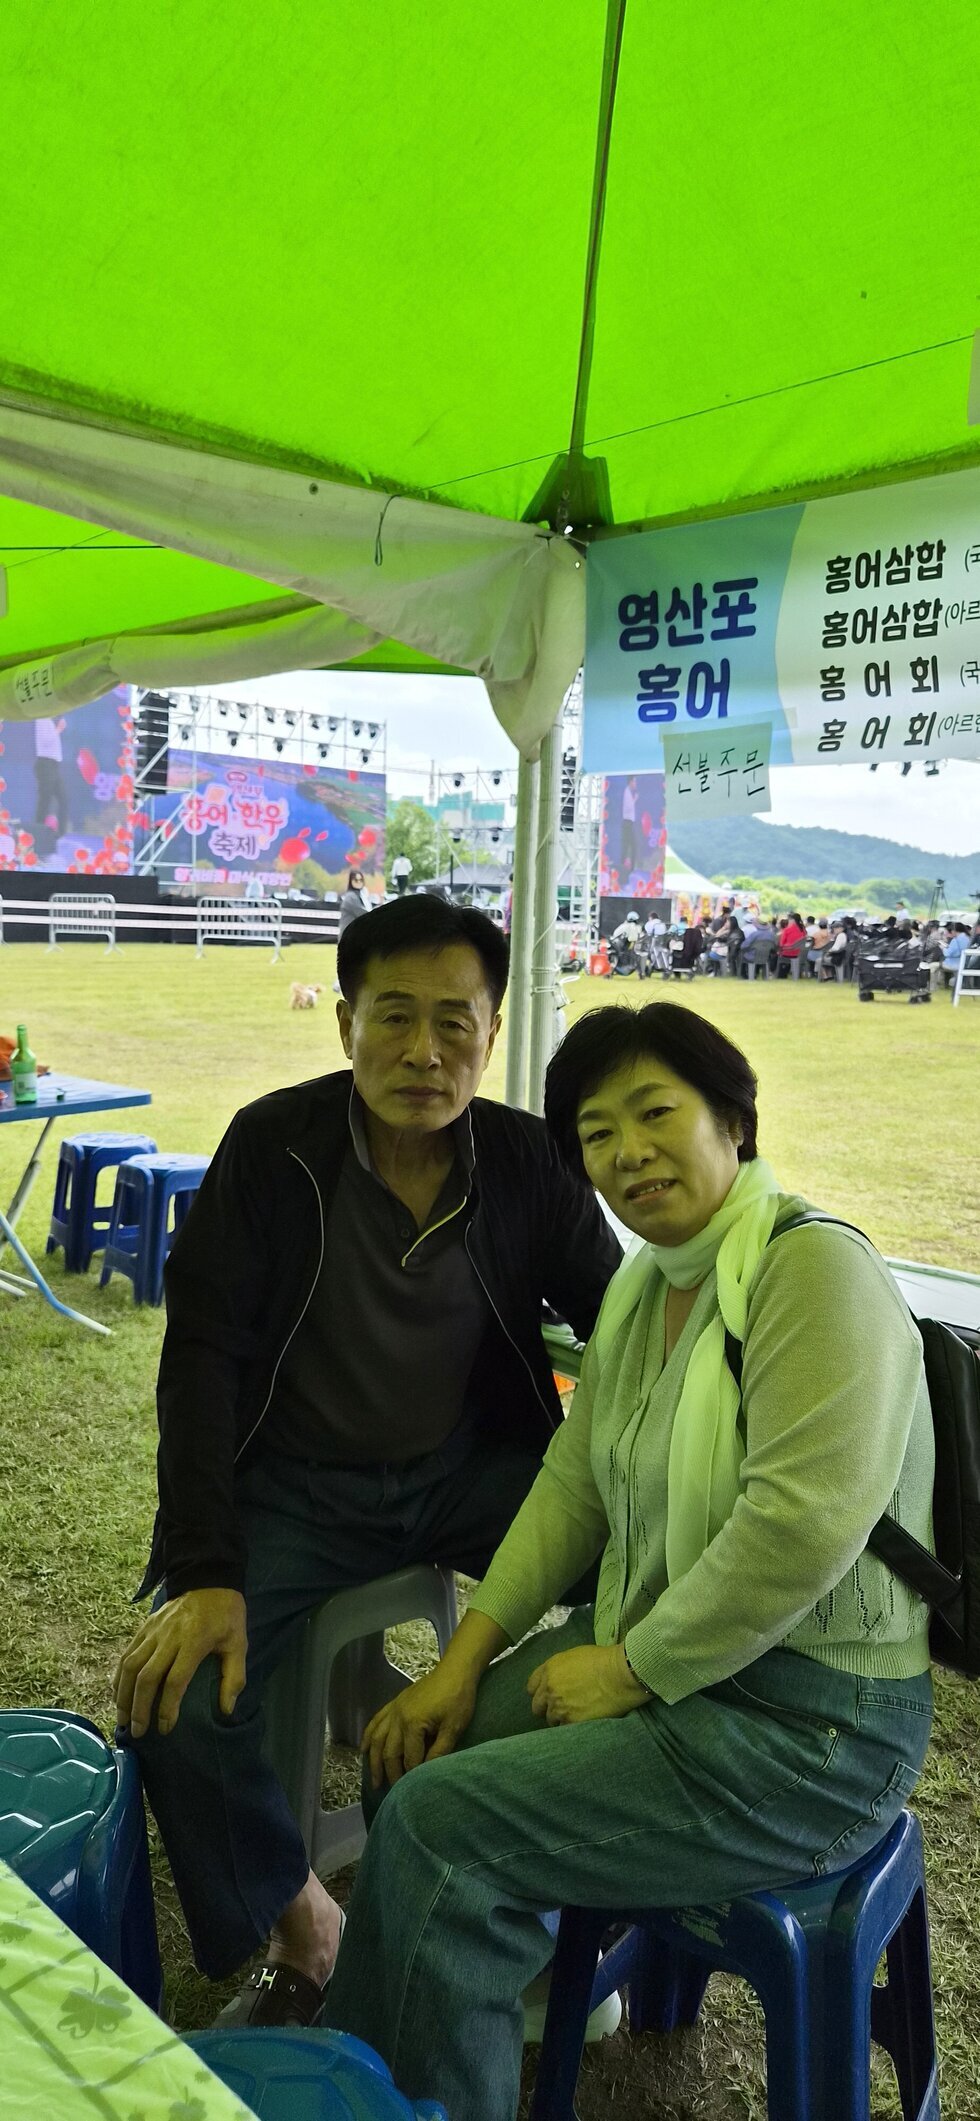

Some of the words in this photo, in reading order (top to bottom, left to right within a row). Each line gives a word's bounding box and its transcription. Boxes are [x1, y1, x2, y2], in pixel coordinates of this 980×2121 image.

[825, 539, 946, 595] 홍어삼합
[617, 577, 758, 652] 영산포
[821, 598, 943, 649] 홍어삼합
[637, 658, 731, 723] 홍어
[212, 831, 256, 857] 축제
